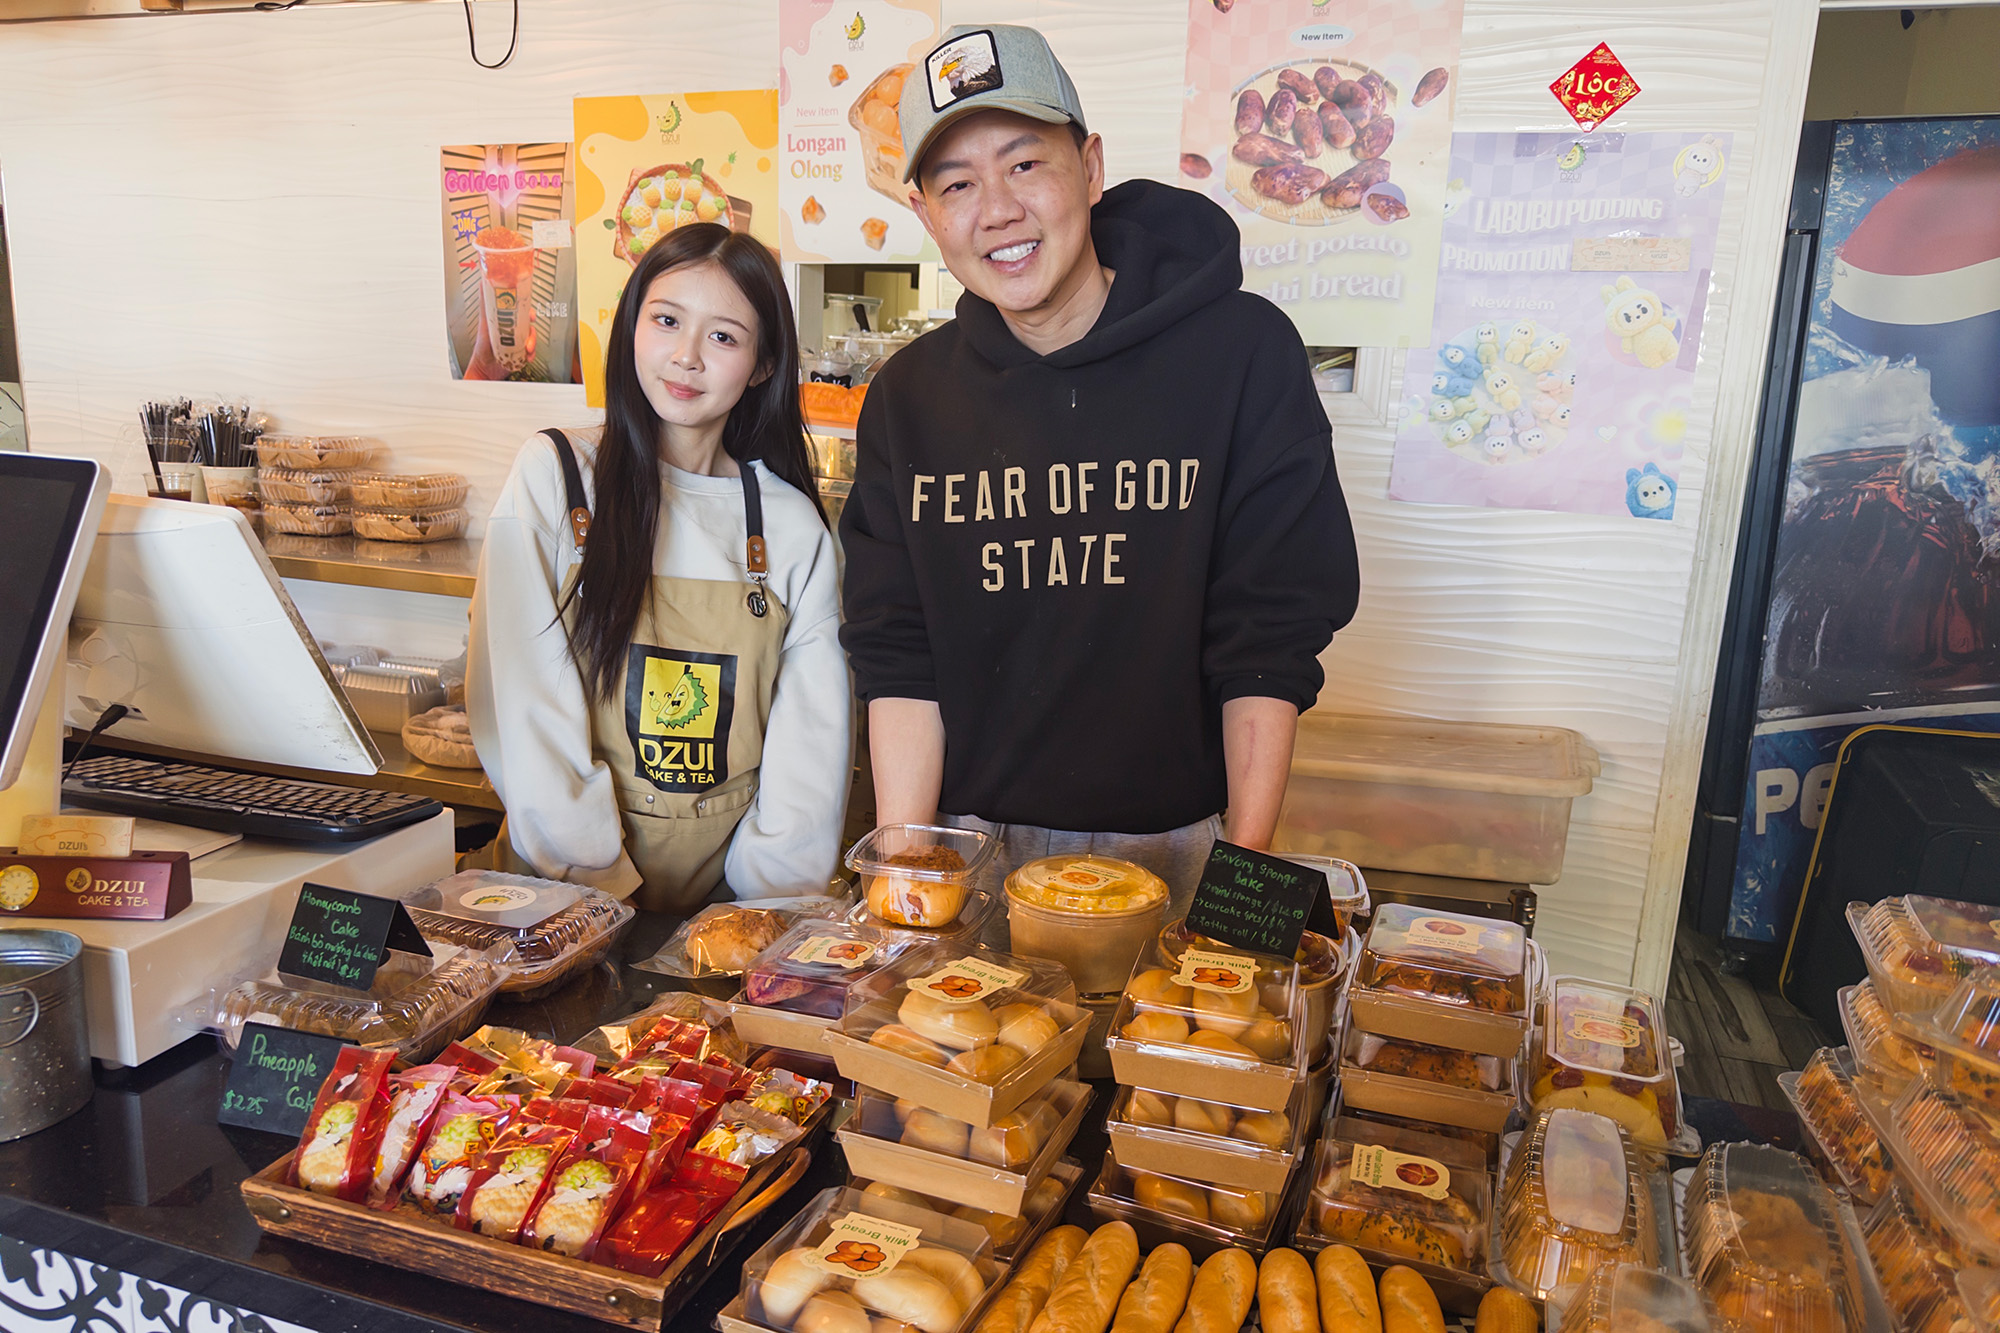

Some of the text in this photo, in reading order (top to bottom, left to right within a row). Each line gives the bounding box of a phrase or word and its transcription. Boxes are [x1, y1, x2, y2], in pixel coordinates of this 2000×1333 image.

[931, 46, 952, 63] KILLER
[1575, 71, 1618, 97] Lộc
[796, 107, 839, 118] New item
[787, 133, 846, 156] Longan
[444, 169, 562, 193] Golden Boba
[791, 159, 843, 182] Olong
[457, 218, 477, 233] OMG
[1474, 199, 1663, 234] LABUBU PUDDING
[1305, 231, 1410, 266] potato
[1442, 244, 1570, 272] PROMOTION
[1310, 270, 1402, 300] bread
[536, 302, 568, 318] LIKE
[1471, 296, 1511, 309] New
[497, 309, 515, 347] DZUI
[912, 458, 1200, 523] FEAR OF GOD
[982, 533, 1127, 592] STATE
[638, 738, 715, 771] DZUI
[644, 764, 715, 784] CAKE & TEA
[93, 879, 146, 894] DZUI
[78, 894, 150, 907] CAKE & TEA
[302, 890, 362, 919] Honeycomb
[330, 918, 360, 938] Cake
[954, 963, 987, 978] Bread
[1187, 956, 1224, 966] Bread
[1228, 962, 1251, 970] Milk
[988, 974, 1010, 985] Milk
[247, 1033, 317, 1082] Pineapple
[285, 1085, 317, 1113] Cak
[841, 1223, 882, 1240] Bread
[883, 1234, 910, 1247] Milk
